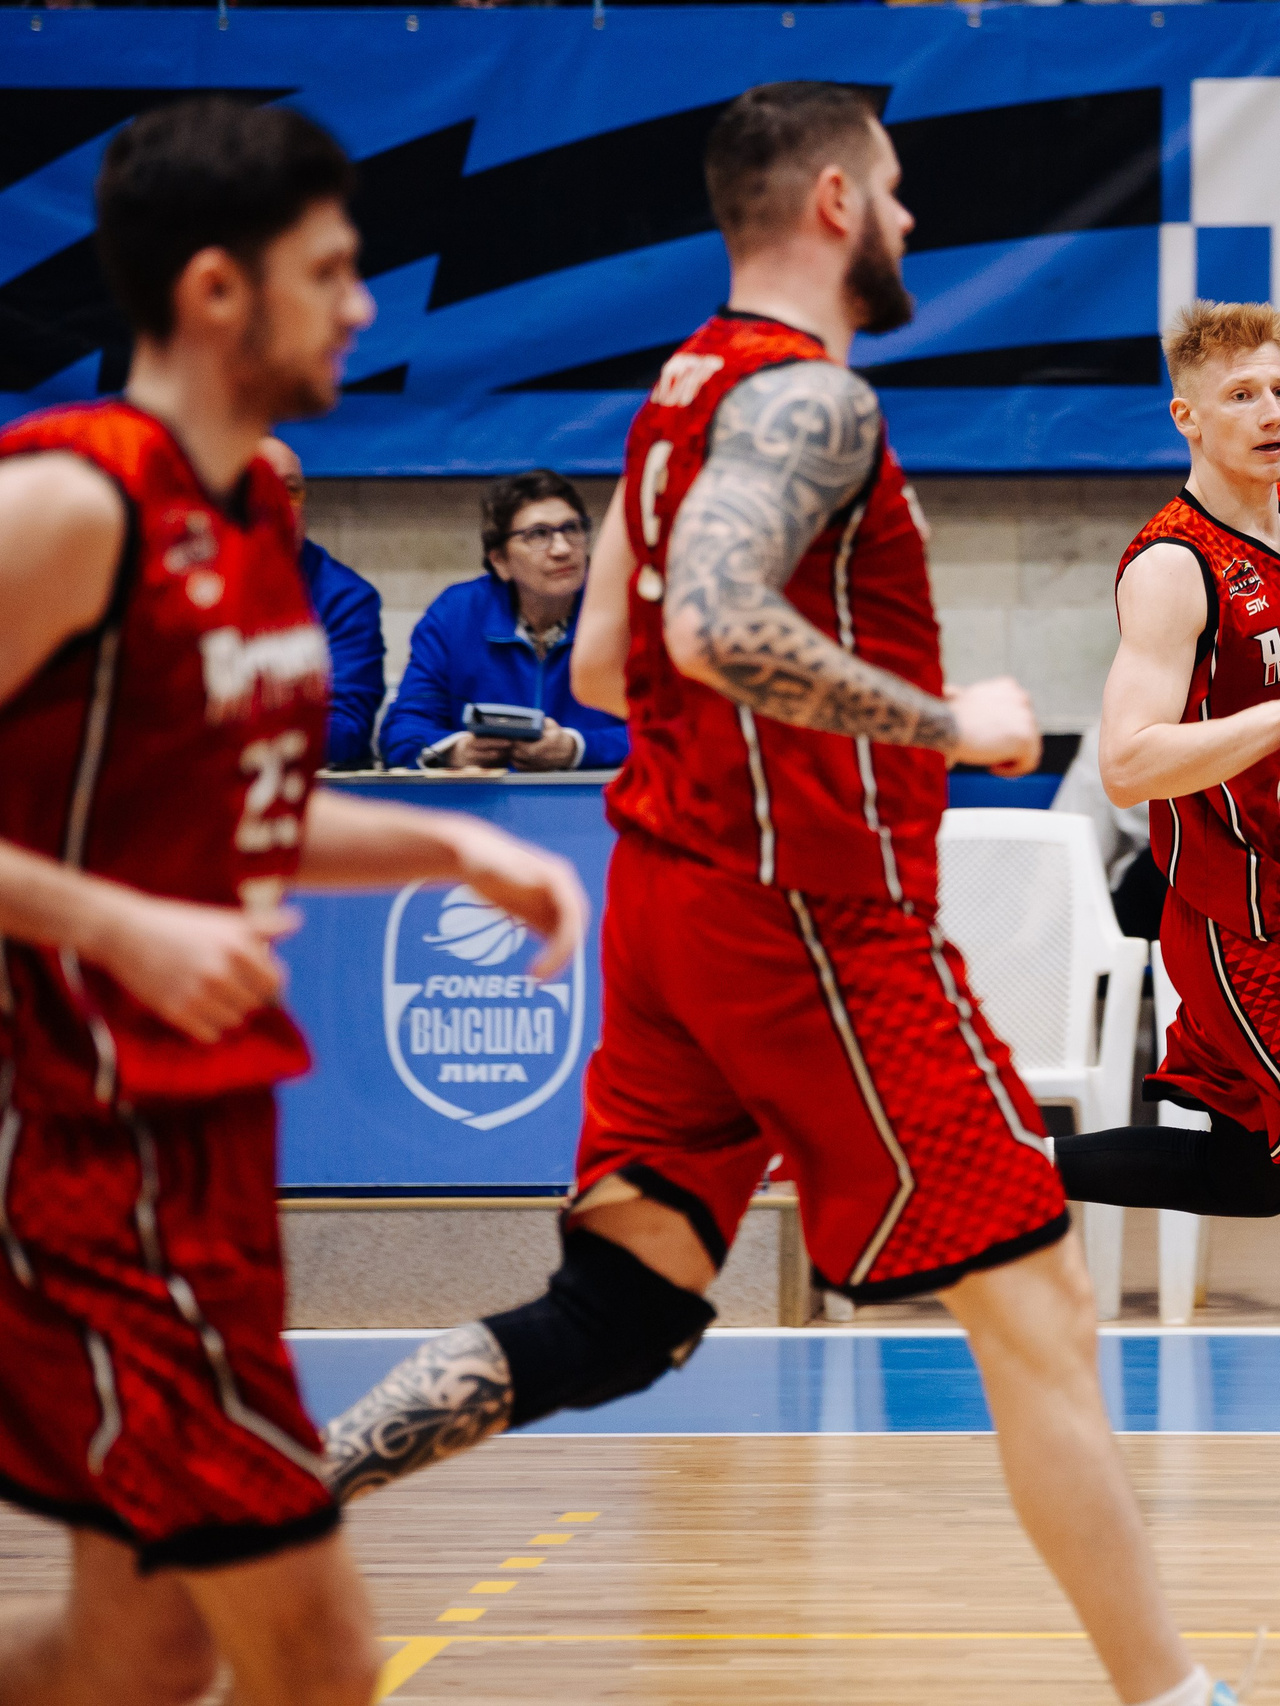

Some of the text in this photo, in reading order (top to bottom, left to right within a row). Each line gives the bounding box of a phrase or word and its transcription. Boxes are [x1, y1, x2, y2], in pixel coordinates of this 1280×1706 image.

[424, 975, 542, 998] FONBET
[411, 1007, 555, 1055] ВЫСШАЯ
[438, 1063, 529, 1083] ЛИГА
